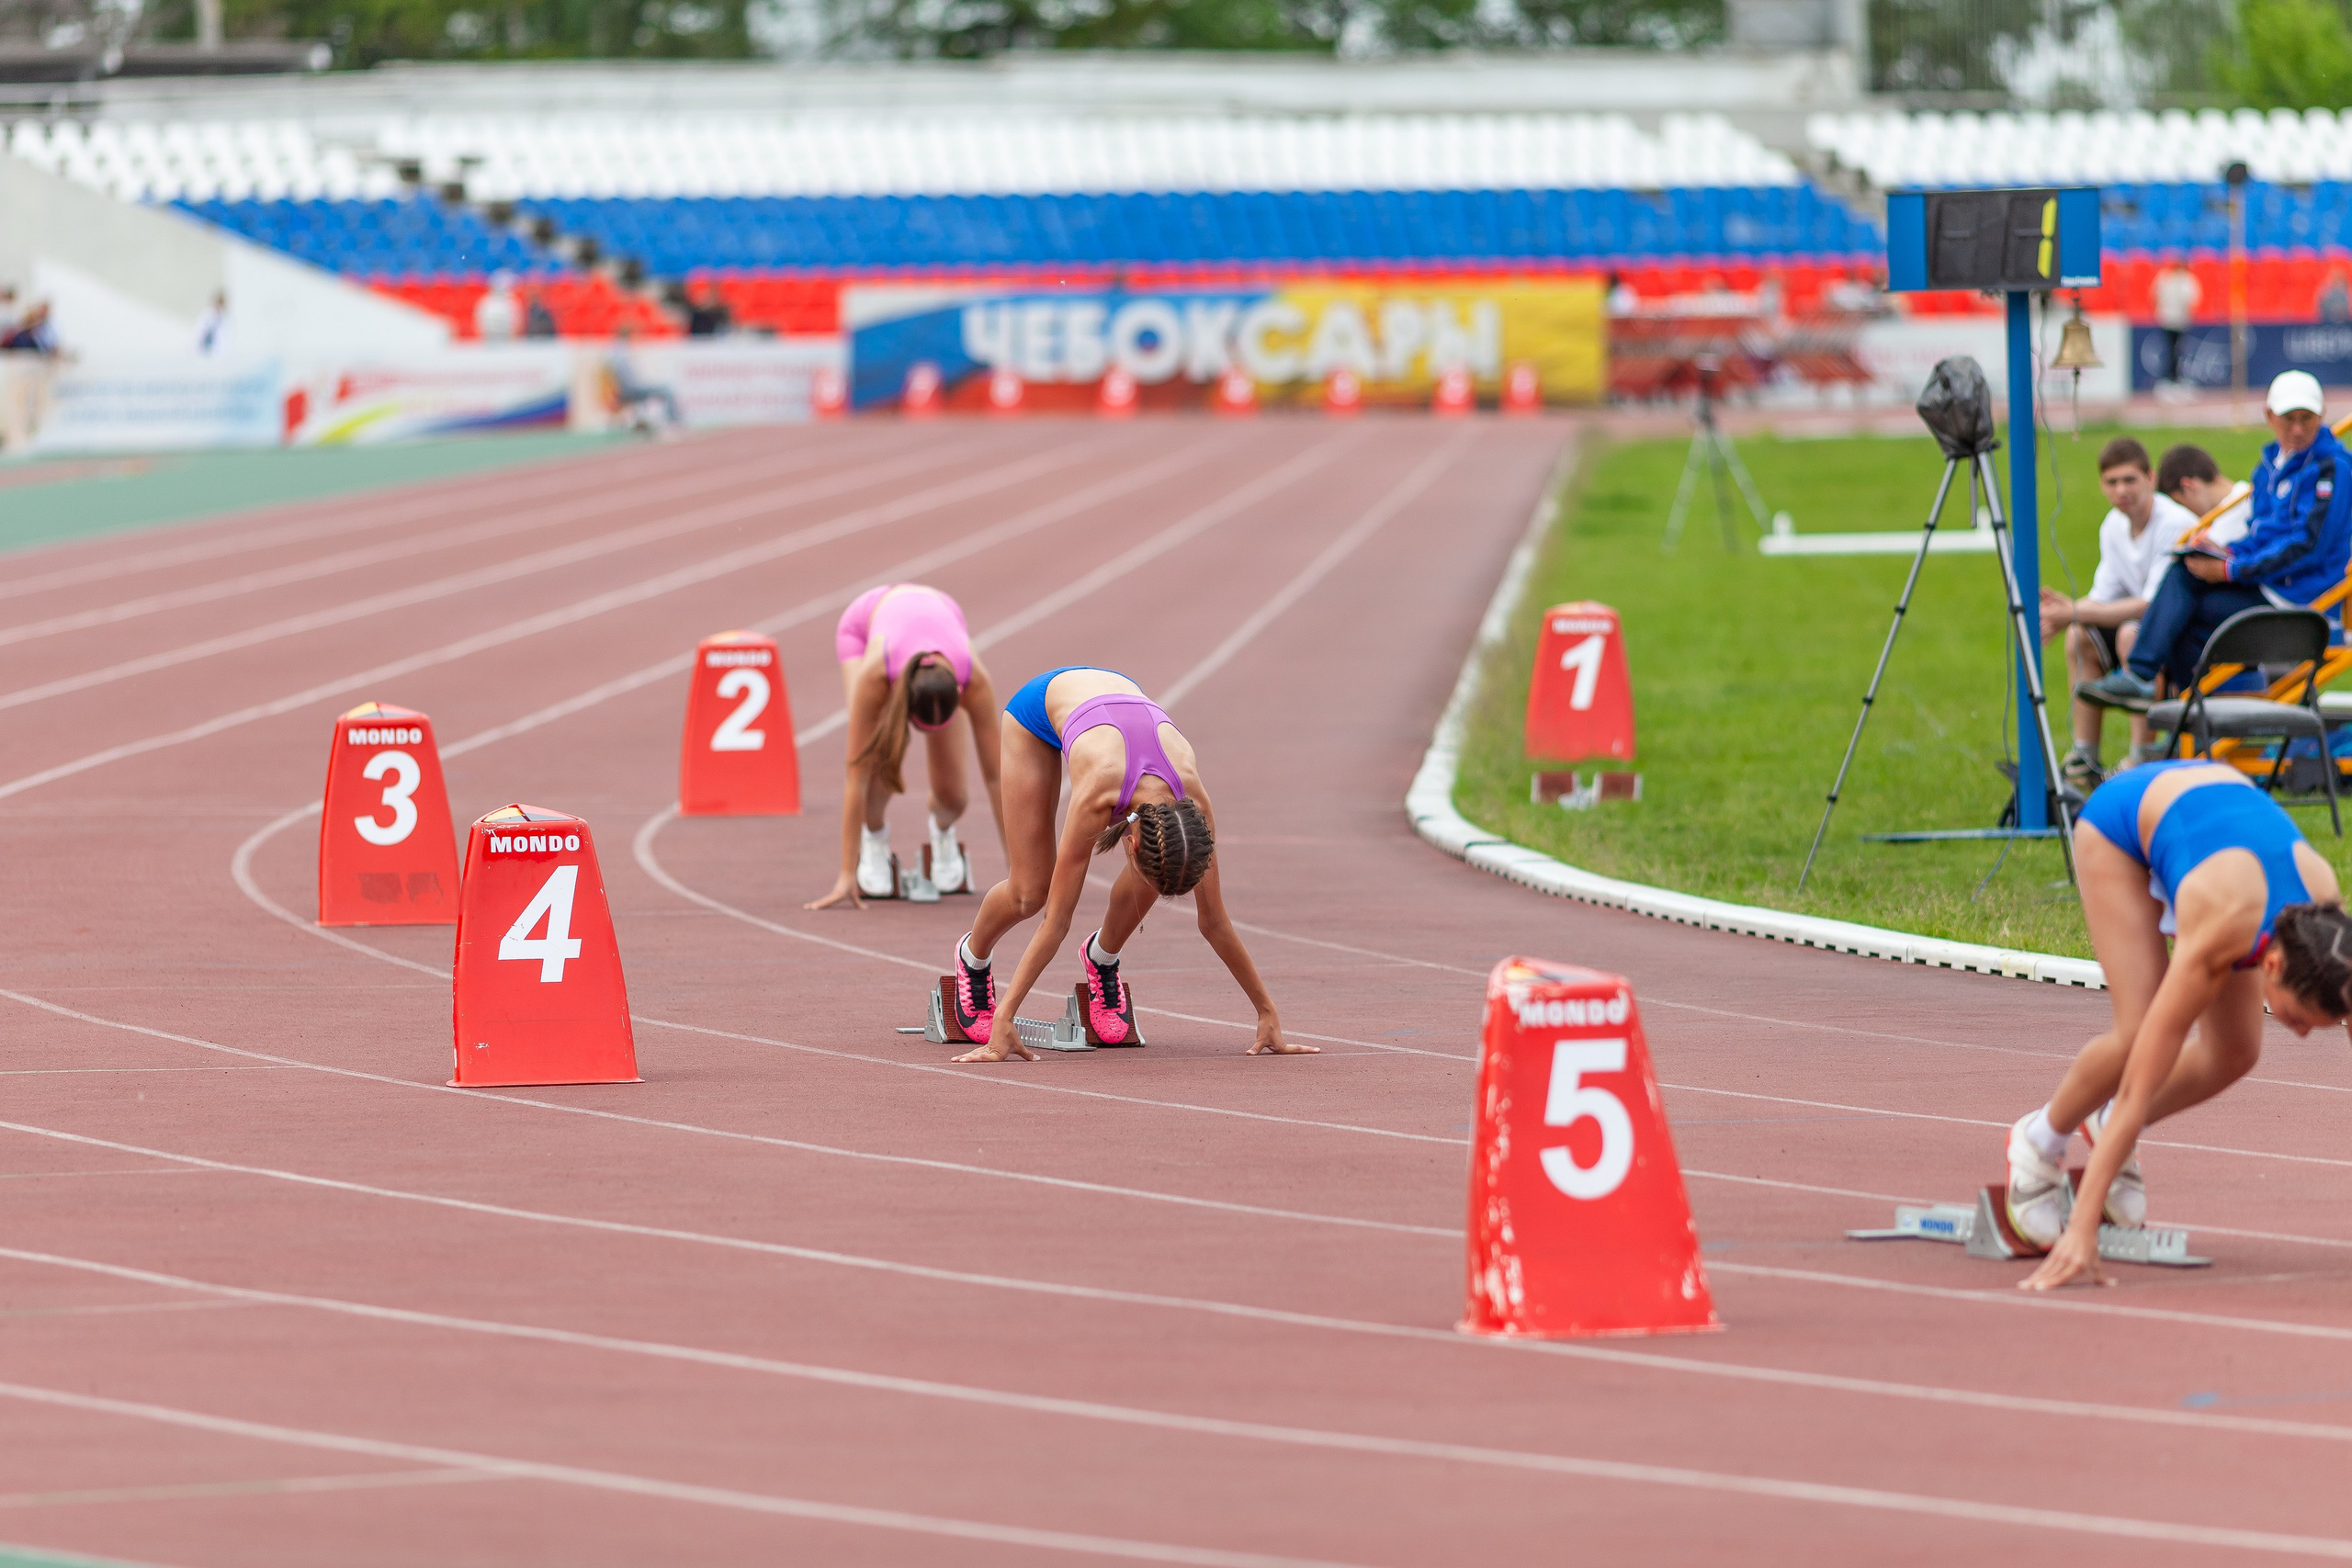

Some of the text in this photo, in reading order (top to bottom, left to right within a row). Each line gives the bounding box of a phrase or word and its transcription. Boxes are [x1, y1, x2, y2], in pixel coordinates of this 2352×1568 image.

[2037, 197, 2057, 279] 1
[962, 299, 1502, 384] ЧЕБОКСАРЫ
[709, 668, 771, 751] 2
[1560, 635, 1606, 710] 1
[348, 727, 423, 745] MONDO
[354, 750, 421, 846] 3
[490, 835, 581, 853] MONDO
[498, 864, 582, 983] 4
[1520, 998, 1629, 1027] MONDO
[1539, 1038, 1634, 1201] 5
